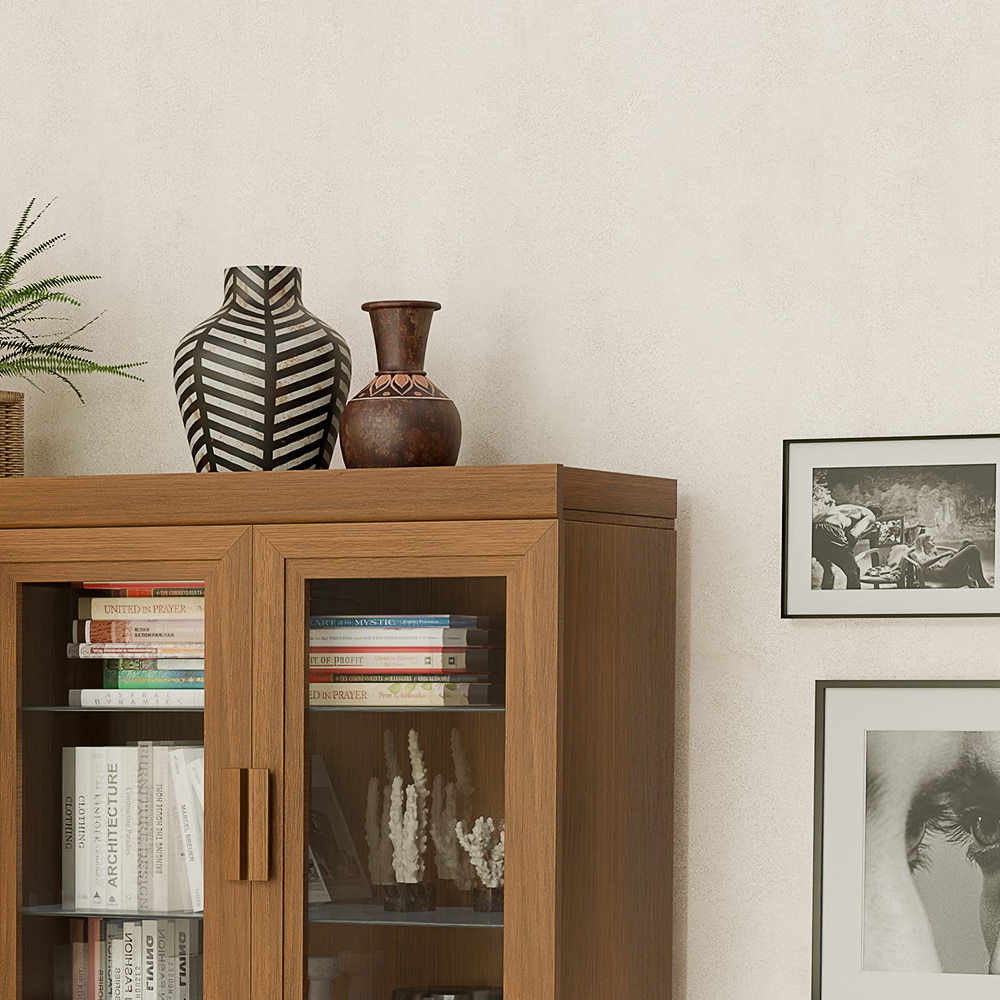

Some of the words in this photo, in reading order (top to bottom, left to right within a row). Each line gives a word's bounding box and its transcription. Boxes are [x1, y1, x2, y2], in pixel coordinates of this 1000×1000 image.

[103, 605, 140, 614] UNITED
[153, 604, 186, 614] PRAYER
[320, 656, 331, 664] OF
[334, 656, 364, 666] PROFIT
[333, 691, 367, 700] PRAYER
[155, 784, 163, 802] HOME
[65, 796, 73, 850] CLOTHING
[78, 795, 86, 849] CLOTHING
[108, 763, 118, 888] ARCHITECTURE
[155, 804, 163, 826] HOUSE
[181, 804, 190, 833] MARCEL
[155, 827, 163, 840] THE
[155, 841, 163, 874] BRINGING
[185, 834, 194, 862] BREUER
[139, 848, 148, 909] DESIGN
